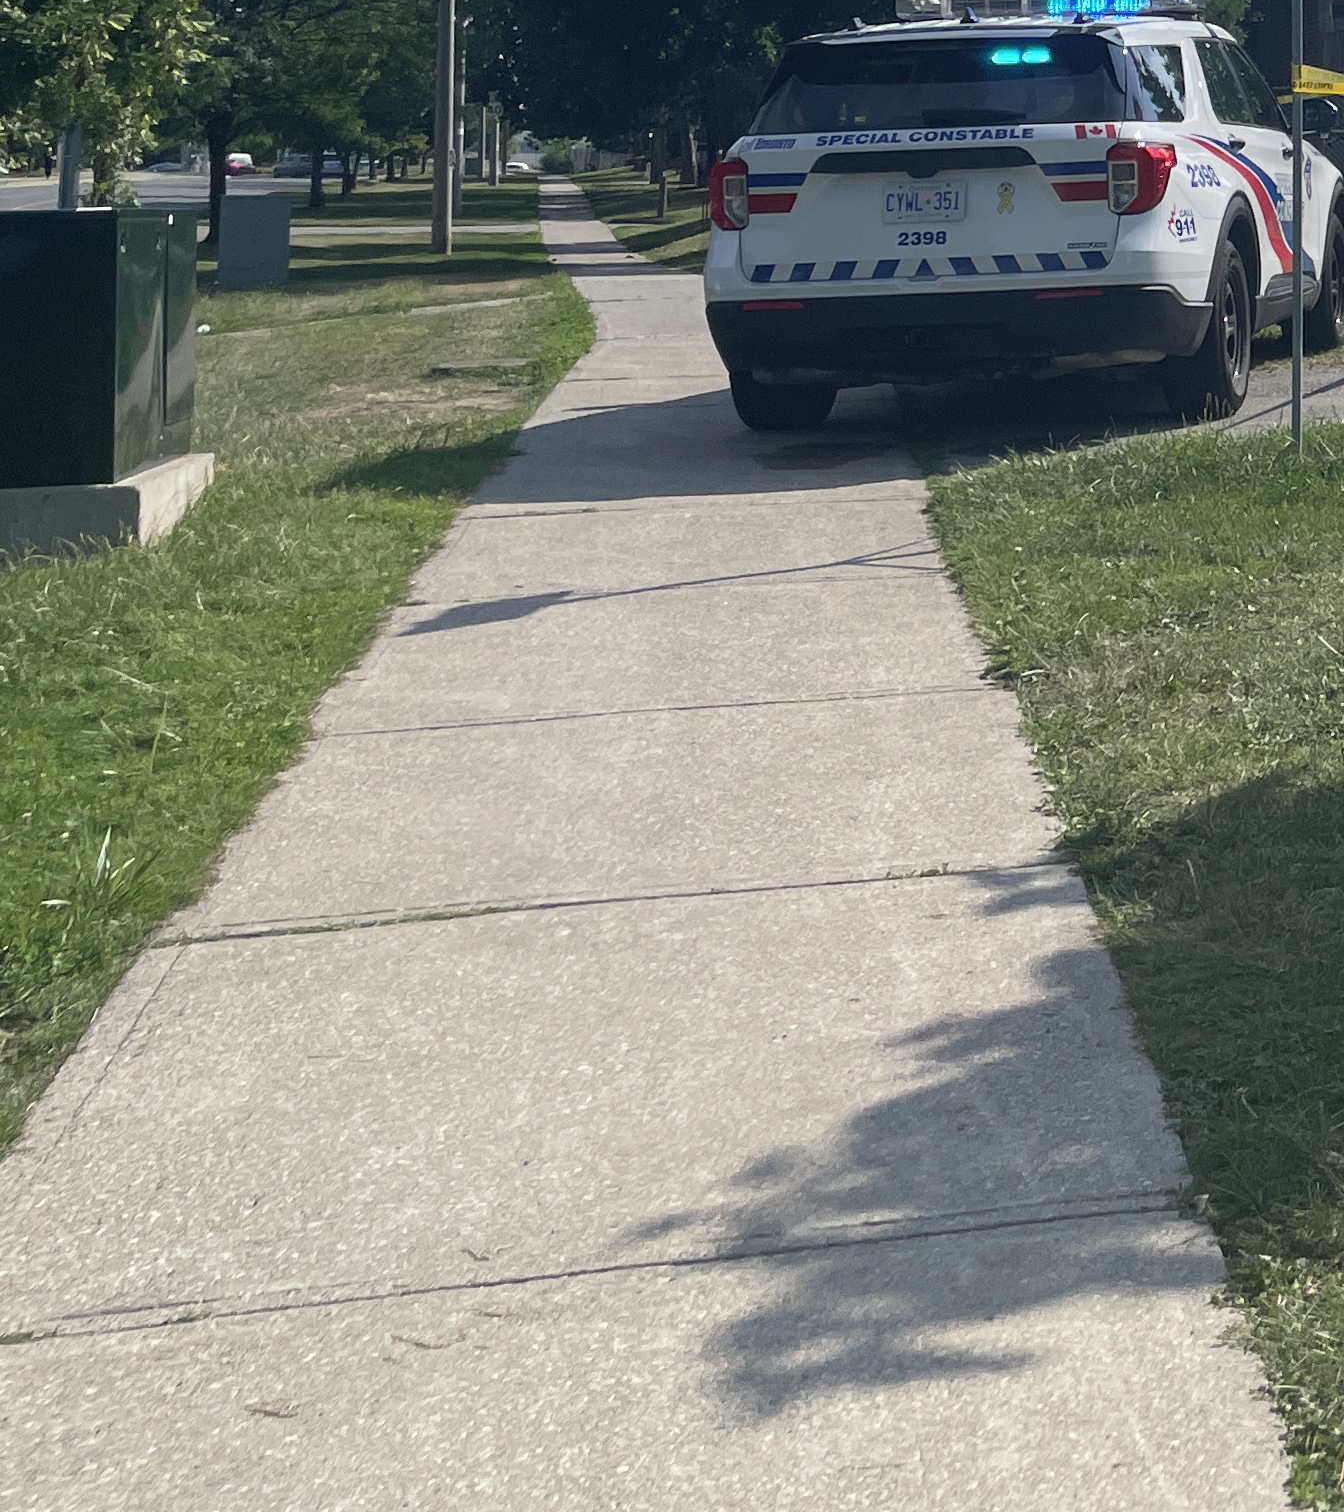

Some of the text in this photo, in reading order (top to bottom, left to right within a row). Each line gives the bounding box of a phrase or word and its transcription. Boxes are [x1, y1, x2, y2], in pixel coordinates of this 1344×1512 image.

[815, 128, 1035, 147] SPECIAL CONSTABLE
[1186, 164, 1221, 188] 2398
[898, 231, 947, 246] 2398
